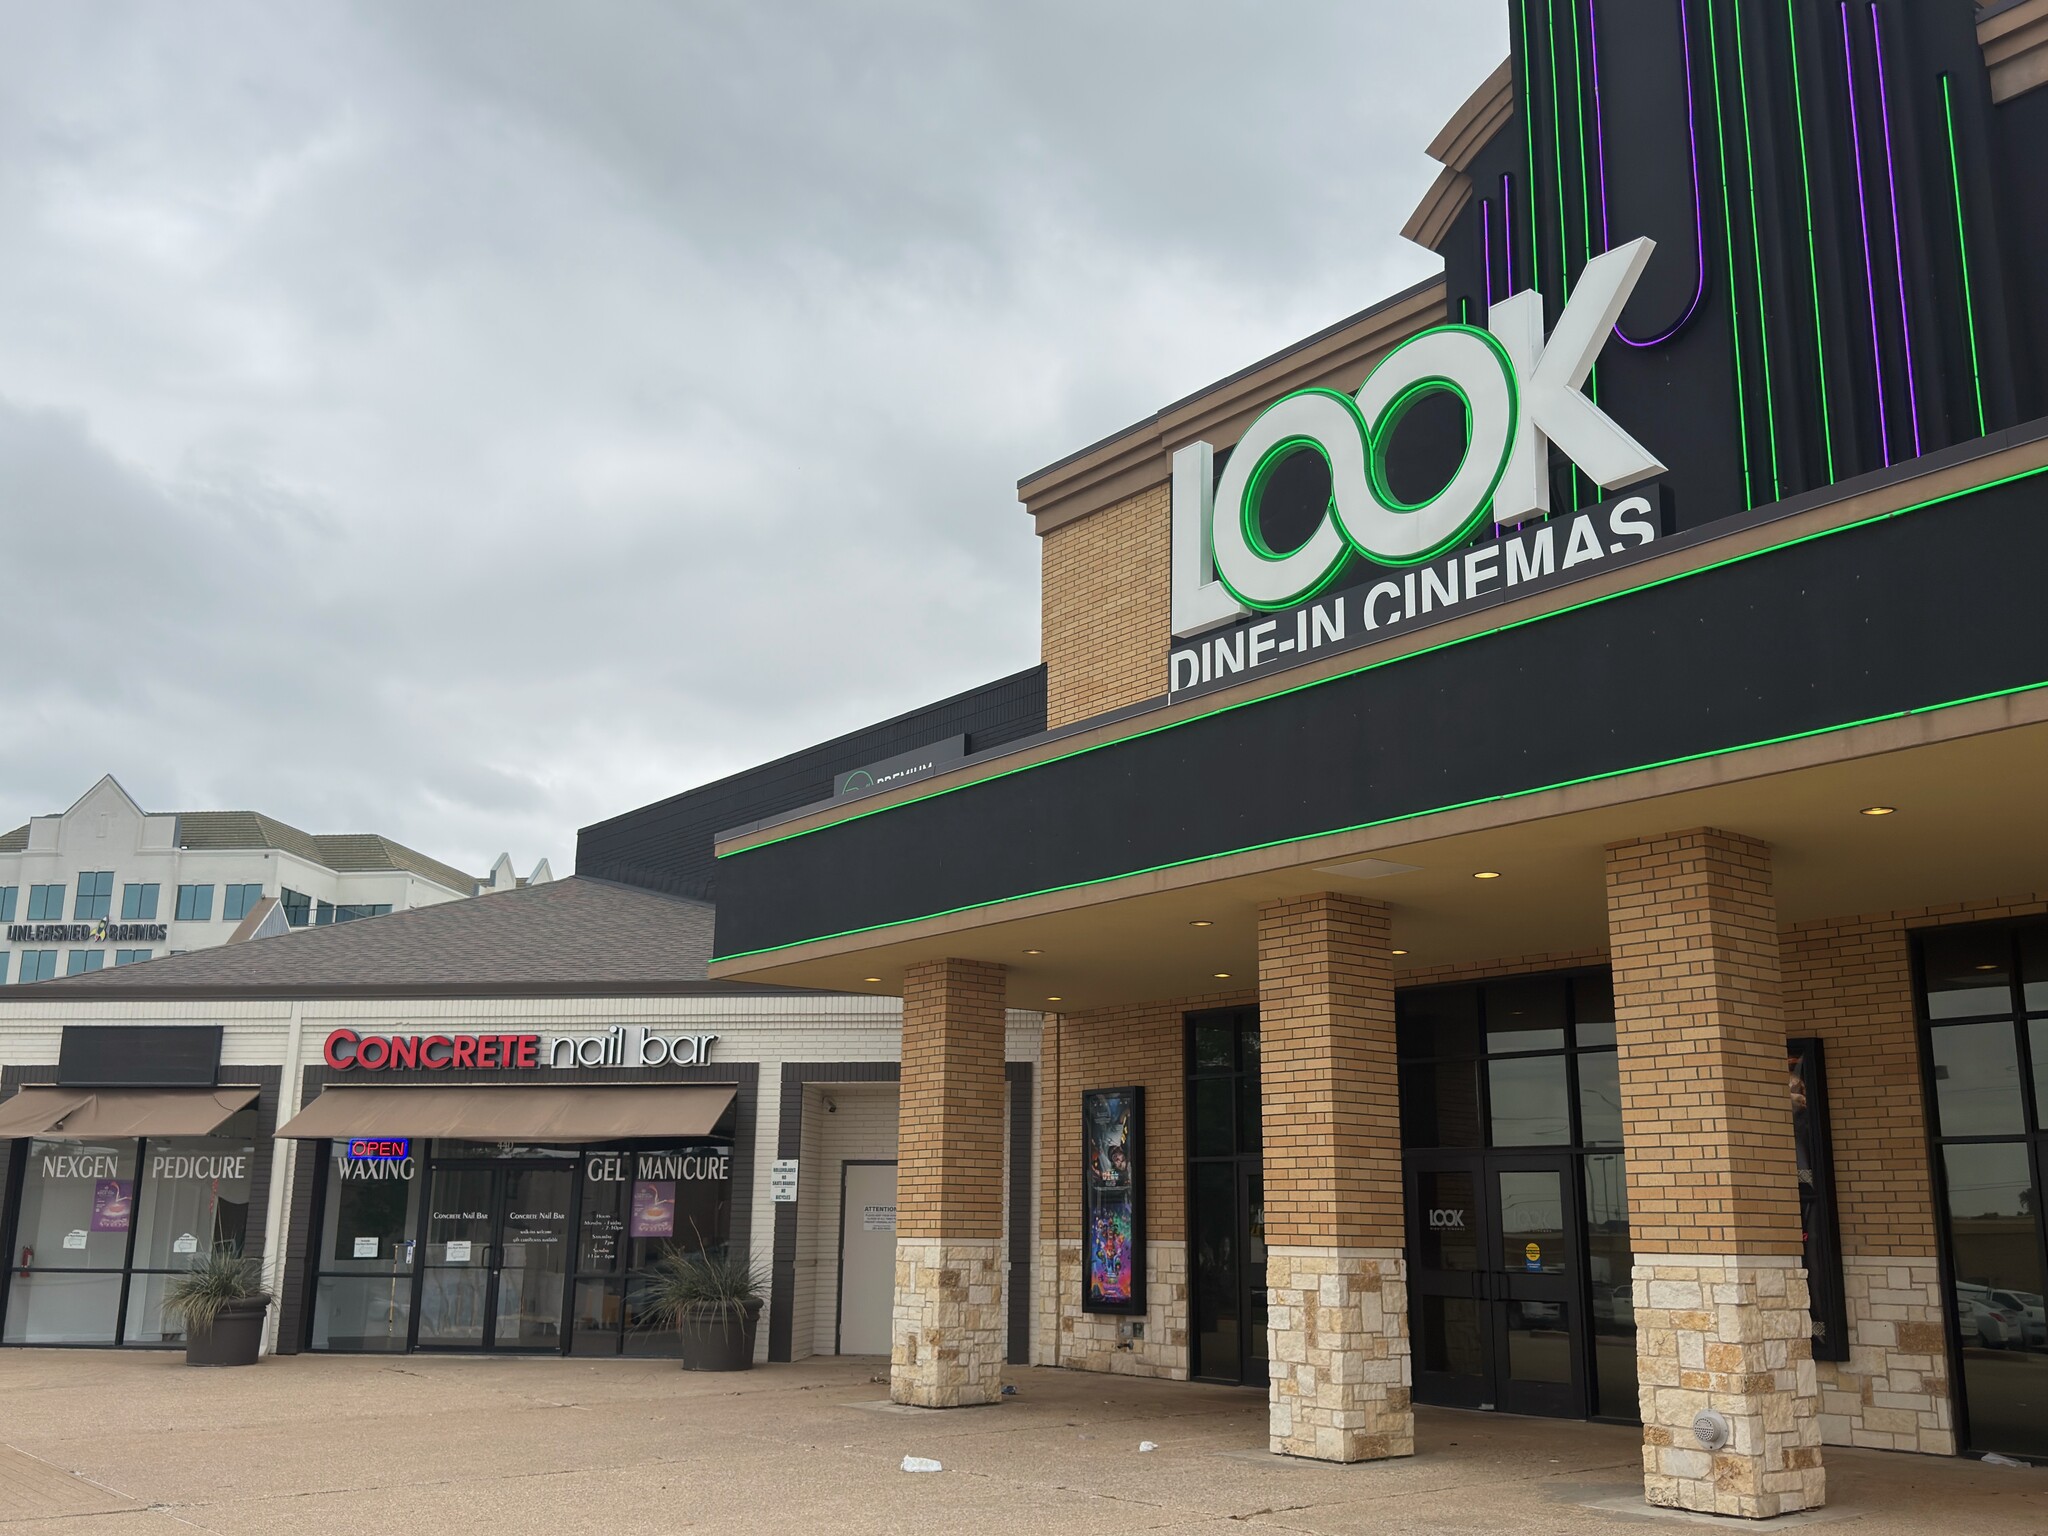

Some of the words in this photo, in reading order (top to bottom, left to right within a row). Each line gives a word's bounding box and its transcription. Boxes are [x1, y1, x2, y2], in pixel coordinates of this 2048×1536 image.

[1172, 236, 1668, 638] LOOK
[1170, 596, 1345, 692] DINE-IN
[1363, 496, 1655, 631] CINEMAS
[7, 924, 91, 941] UNLEASHED
[109, 924, 168, 941] BRANDS
[324, 1028, 541, 1070] CONCRETE
[550, 1025, 626, 1066] nail
[640, 1027, 719, 1066] bar
[352, 1141, 404, 1156] OPEN
[42, 1155, 119, 1178] NEXGEN
[152, 1156, 246, 1179] PEDICURE
[338, 1157, 415, 1180] WAXING
[587, 1158, 626, 1181] GEL
[638, 1156, 729, 1180] MANICURE
[1429, 1209, 1465, 1226] LOOK
